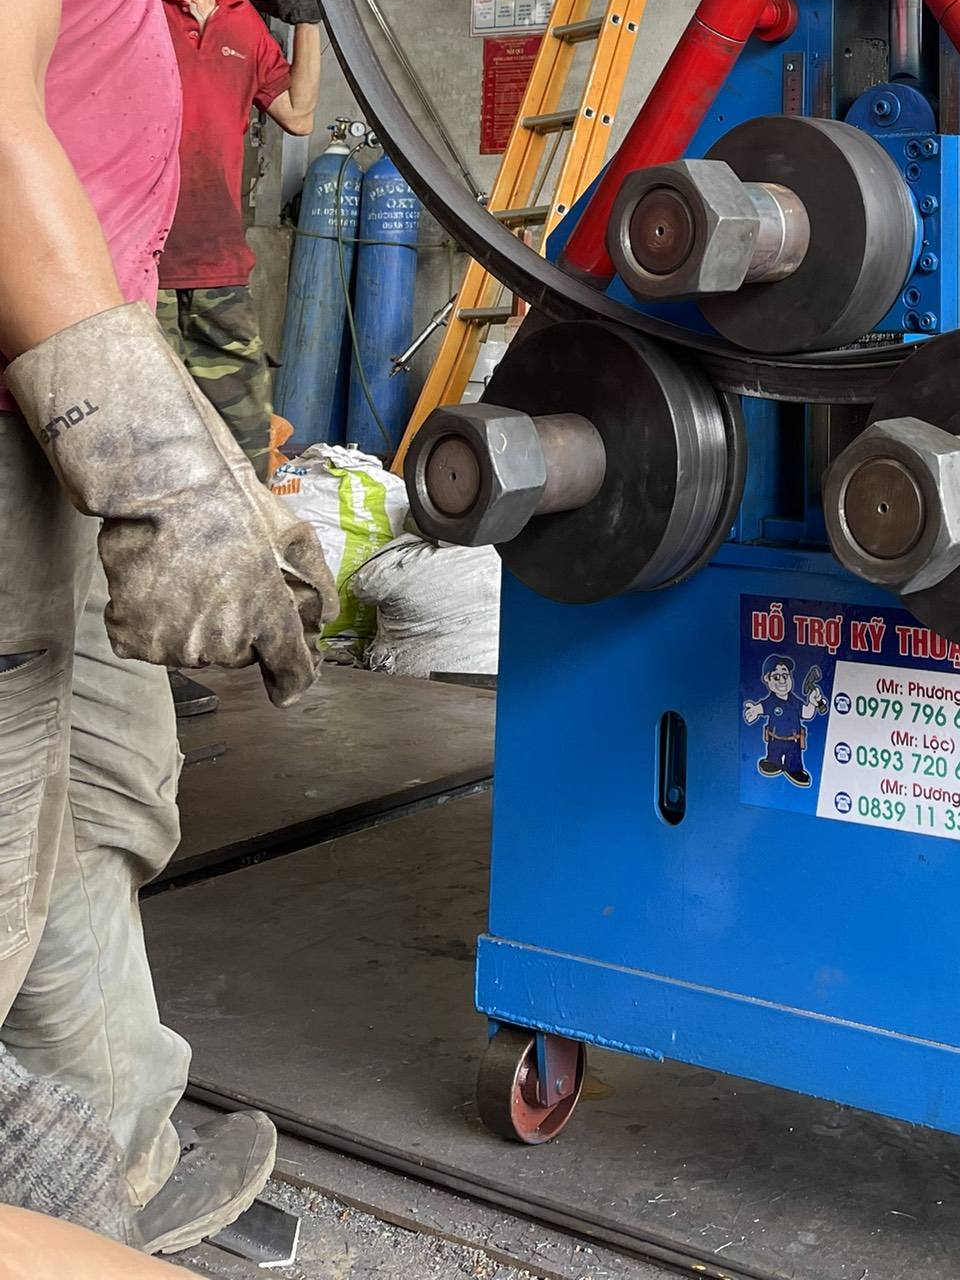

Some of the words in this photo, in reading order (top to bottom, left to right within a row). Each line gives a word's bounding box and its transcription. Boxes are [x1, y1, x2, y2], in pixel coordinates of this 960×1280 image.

[752, 602, 785, 643] HỖ
[793, 615, 842, 655] TRỢ
[850, 617, 886, 653] KỸ
[876, 678, 903, 695] (Mr:
[855, 695, 903, 720] 0979
[910, 702, 947, 727] 796
[891, 730, 918, 748] (Mr:
[923, 733, 955, 753] Lộc)
[856, 746, 904, 771] 0393
[911, 753, 948, 778] 720
[880, 778, 907, 796] (Mr:
[858, 795, 906, 822] 0839
[916, 804, 934, 827] 11
